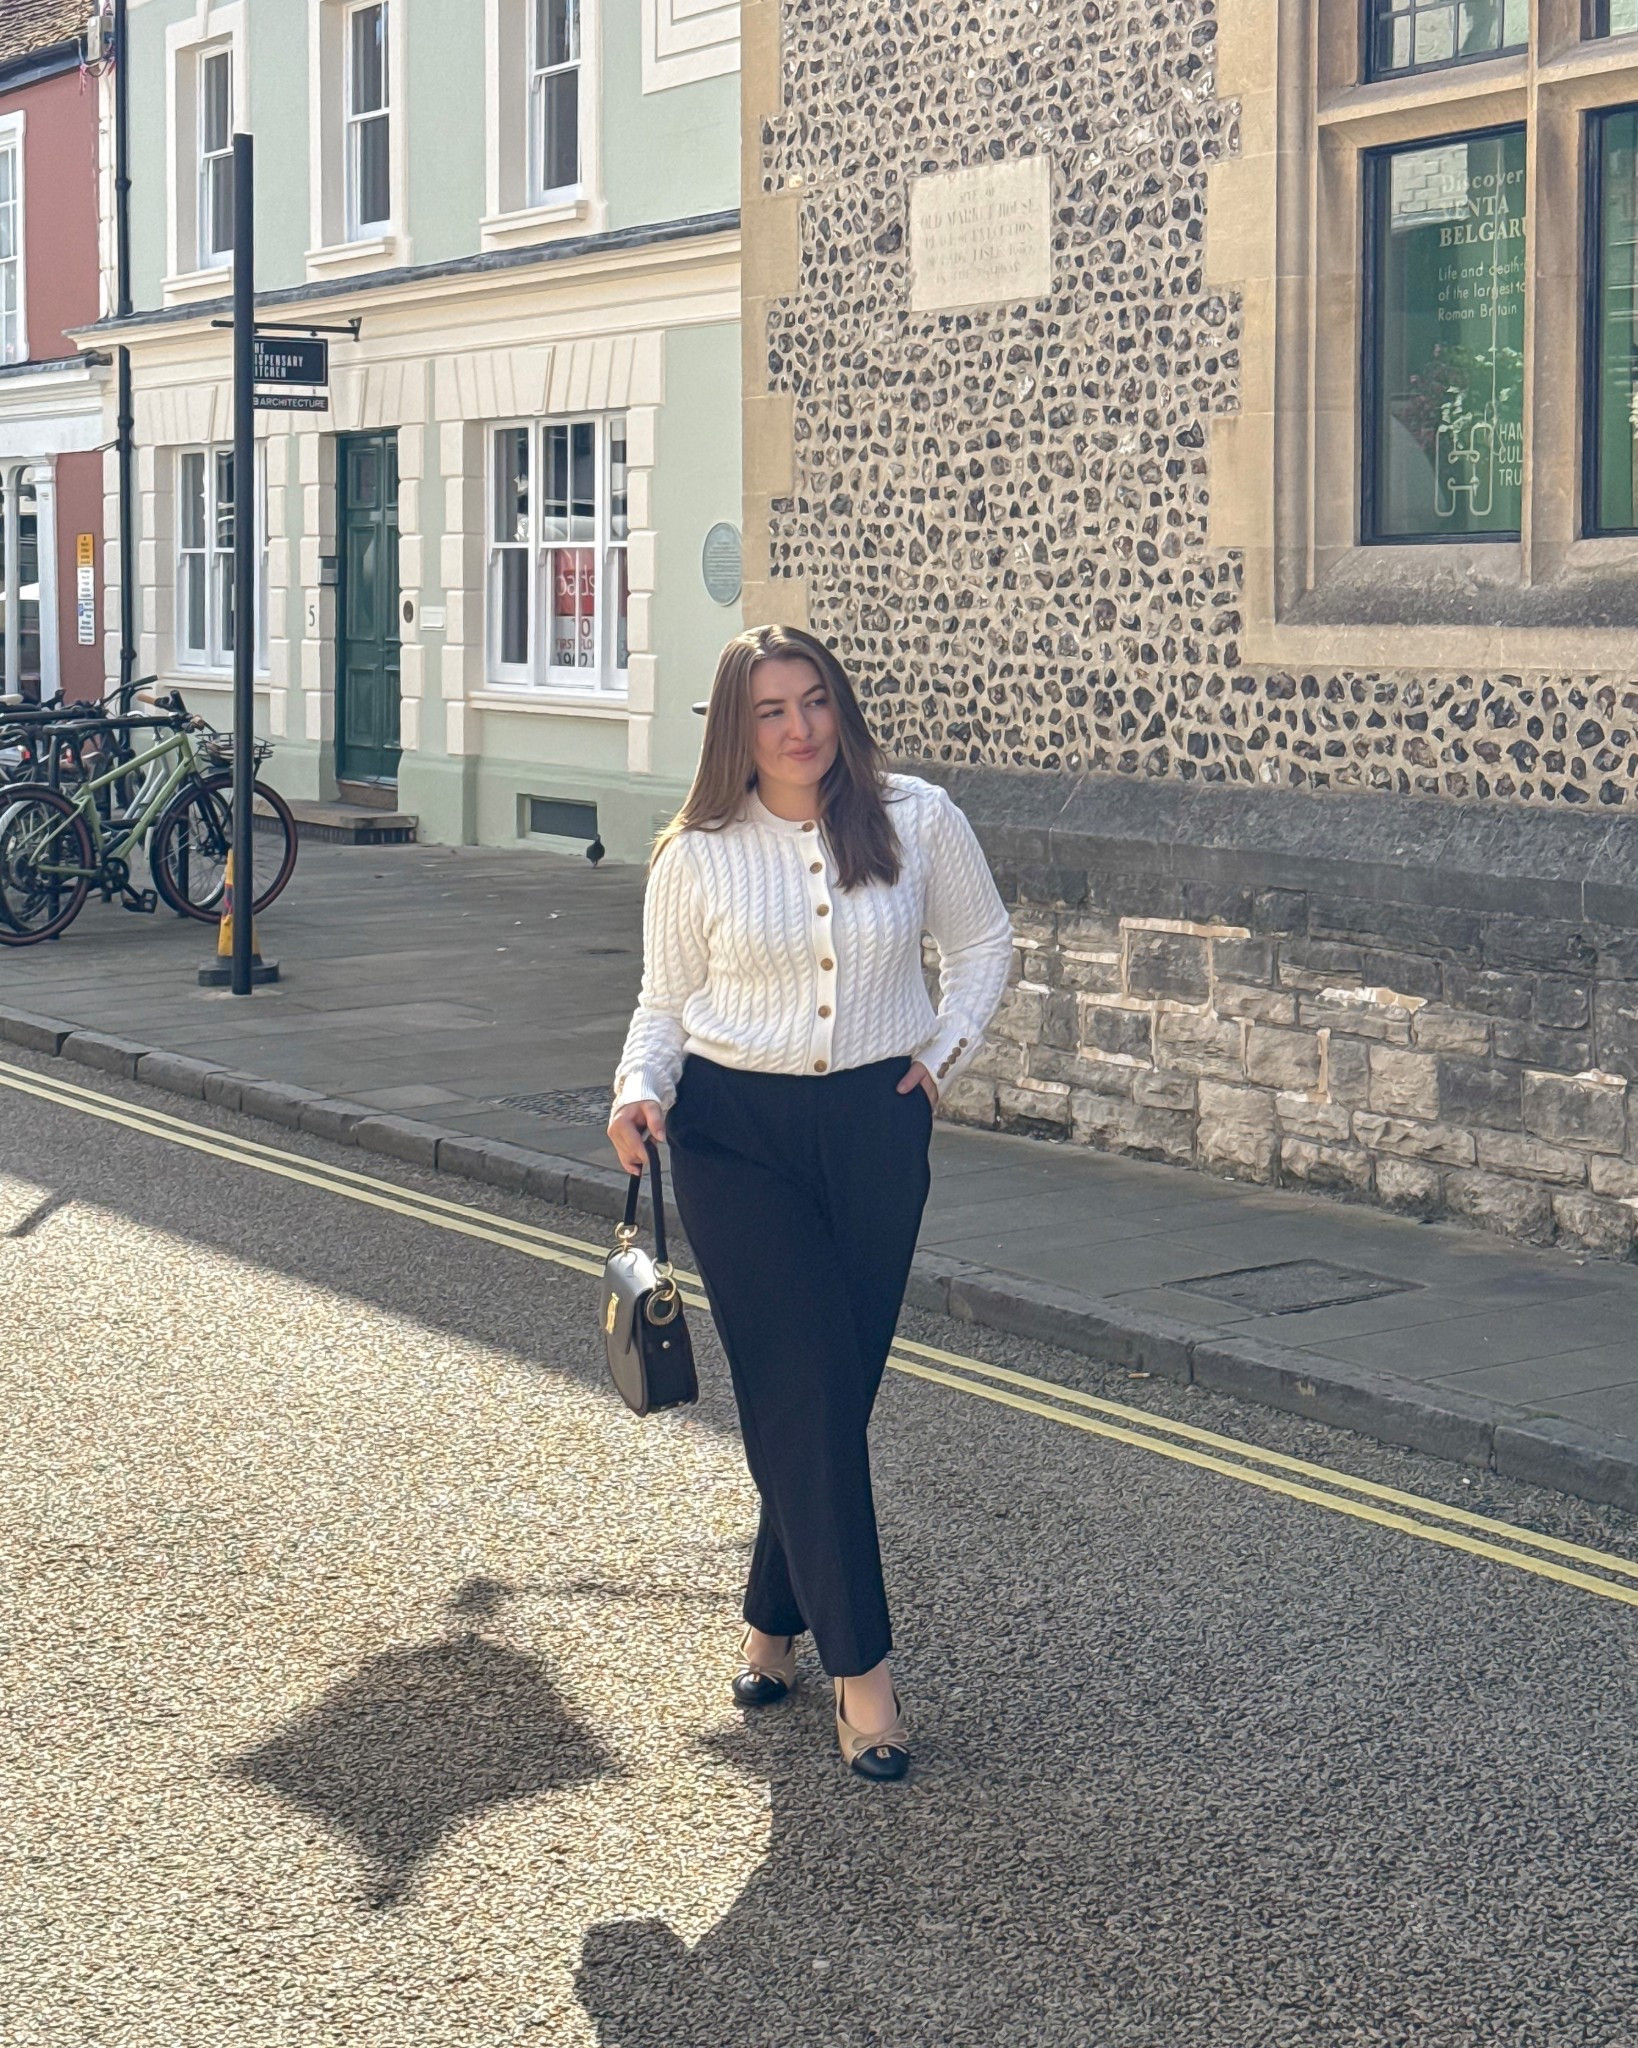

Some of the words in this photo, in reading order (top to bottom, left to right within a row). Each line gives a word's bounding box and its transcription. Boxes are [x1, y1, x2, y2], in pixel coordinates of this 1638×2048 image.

[1442, 169, 1524, 193] Discover
[1438, 263, 1457, 281] Life
[1460, 260, 1484, 278] and
[1489, 255, 1520, 276] death
[1438, 285, 1450, 301] of
[1453, 285, 1469, 299] the
[1438, 307, 1475, 321] Roman
[1480, 303, 1517, 318] Brtain
[254, 342, 265, 354] HE
[254, 354, 304, 367] ISPENSARY
[254, 365, 287, 378] ITCHEN
[260, 397, 326, 409] ARCHITECTURE
[1498, 445, 1524, 464] CUL
[1499, 468, 1523, 487] TRU
[308, 604, 316, 627] 5
